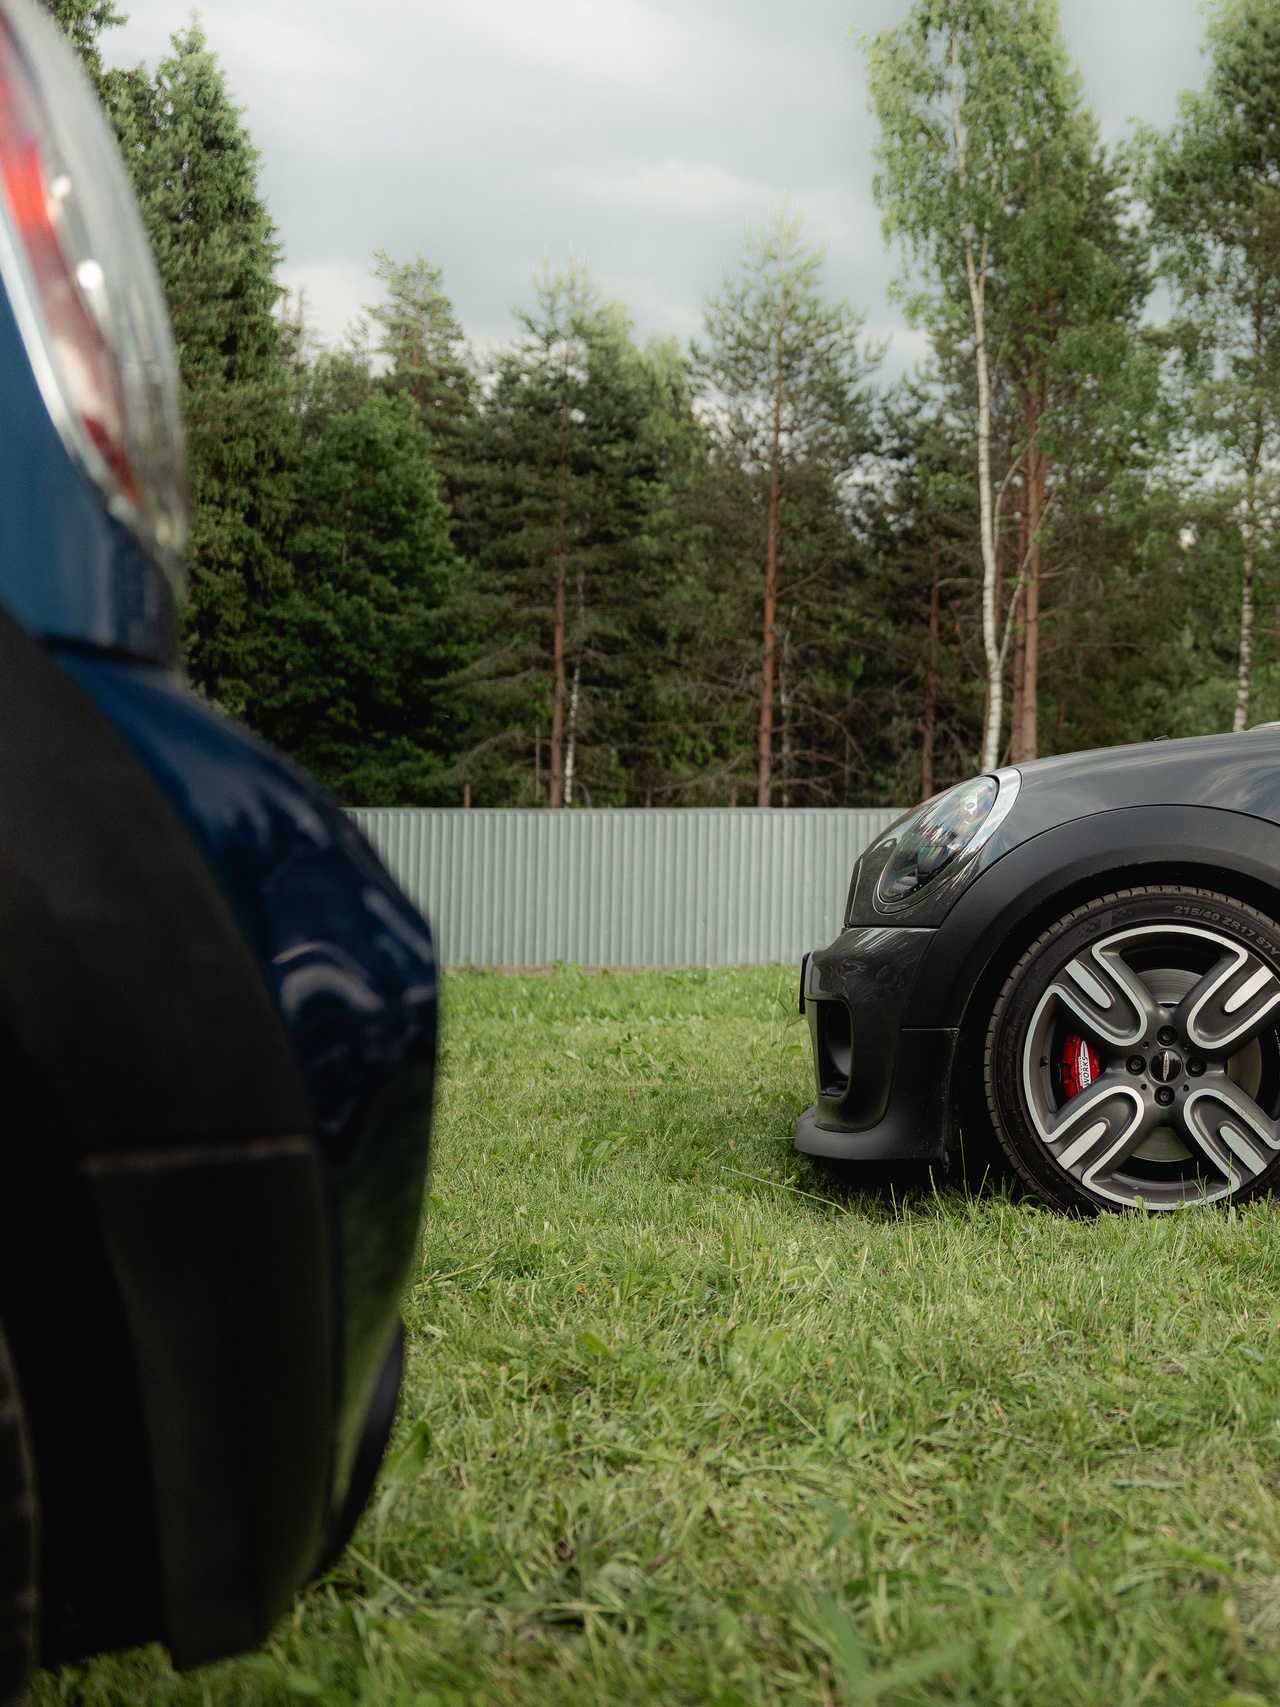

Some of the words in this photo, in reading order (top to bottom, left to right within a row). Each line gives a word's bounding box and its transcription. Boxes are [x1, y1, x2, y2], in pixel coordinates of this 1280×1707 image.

[1174, 905, 1220, 920] 215/40
[1222, 917, 1256, 937] ZR17
[1256, 937, 1280, 956] 87Y
[1082, 1056, 1090, 1087] WORKS
